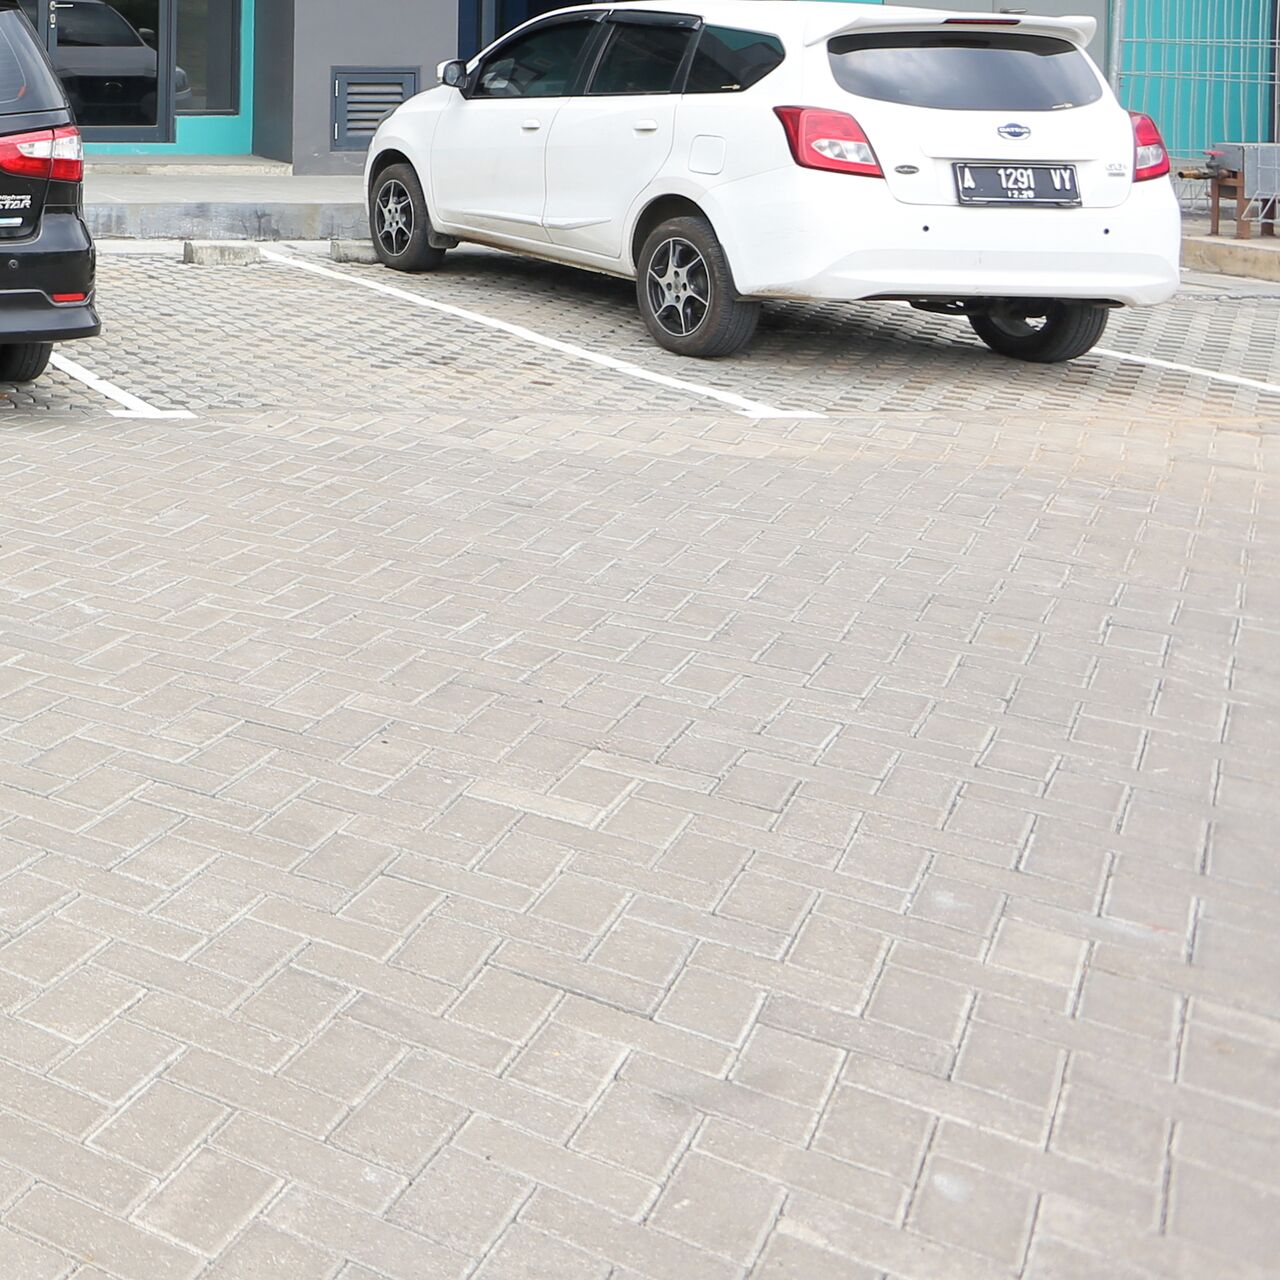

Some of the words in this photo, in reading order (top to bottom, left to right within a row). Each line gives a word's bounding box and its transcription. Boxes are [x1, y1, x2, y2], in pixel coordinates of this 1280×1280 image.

[963, 167, 975, 189] A
[997, 168, 1035, 190] 1291
[1050, 169, 1071, 190] VY
